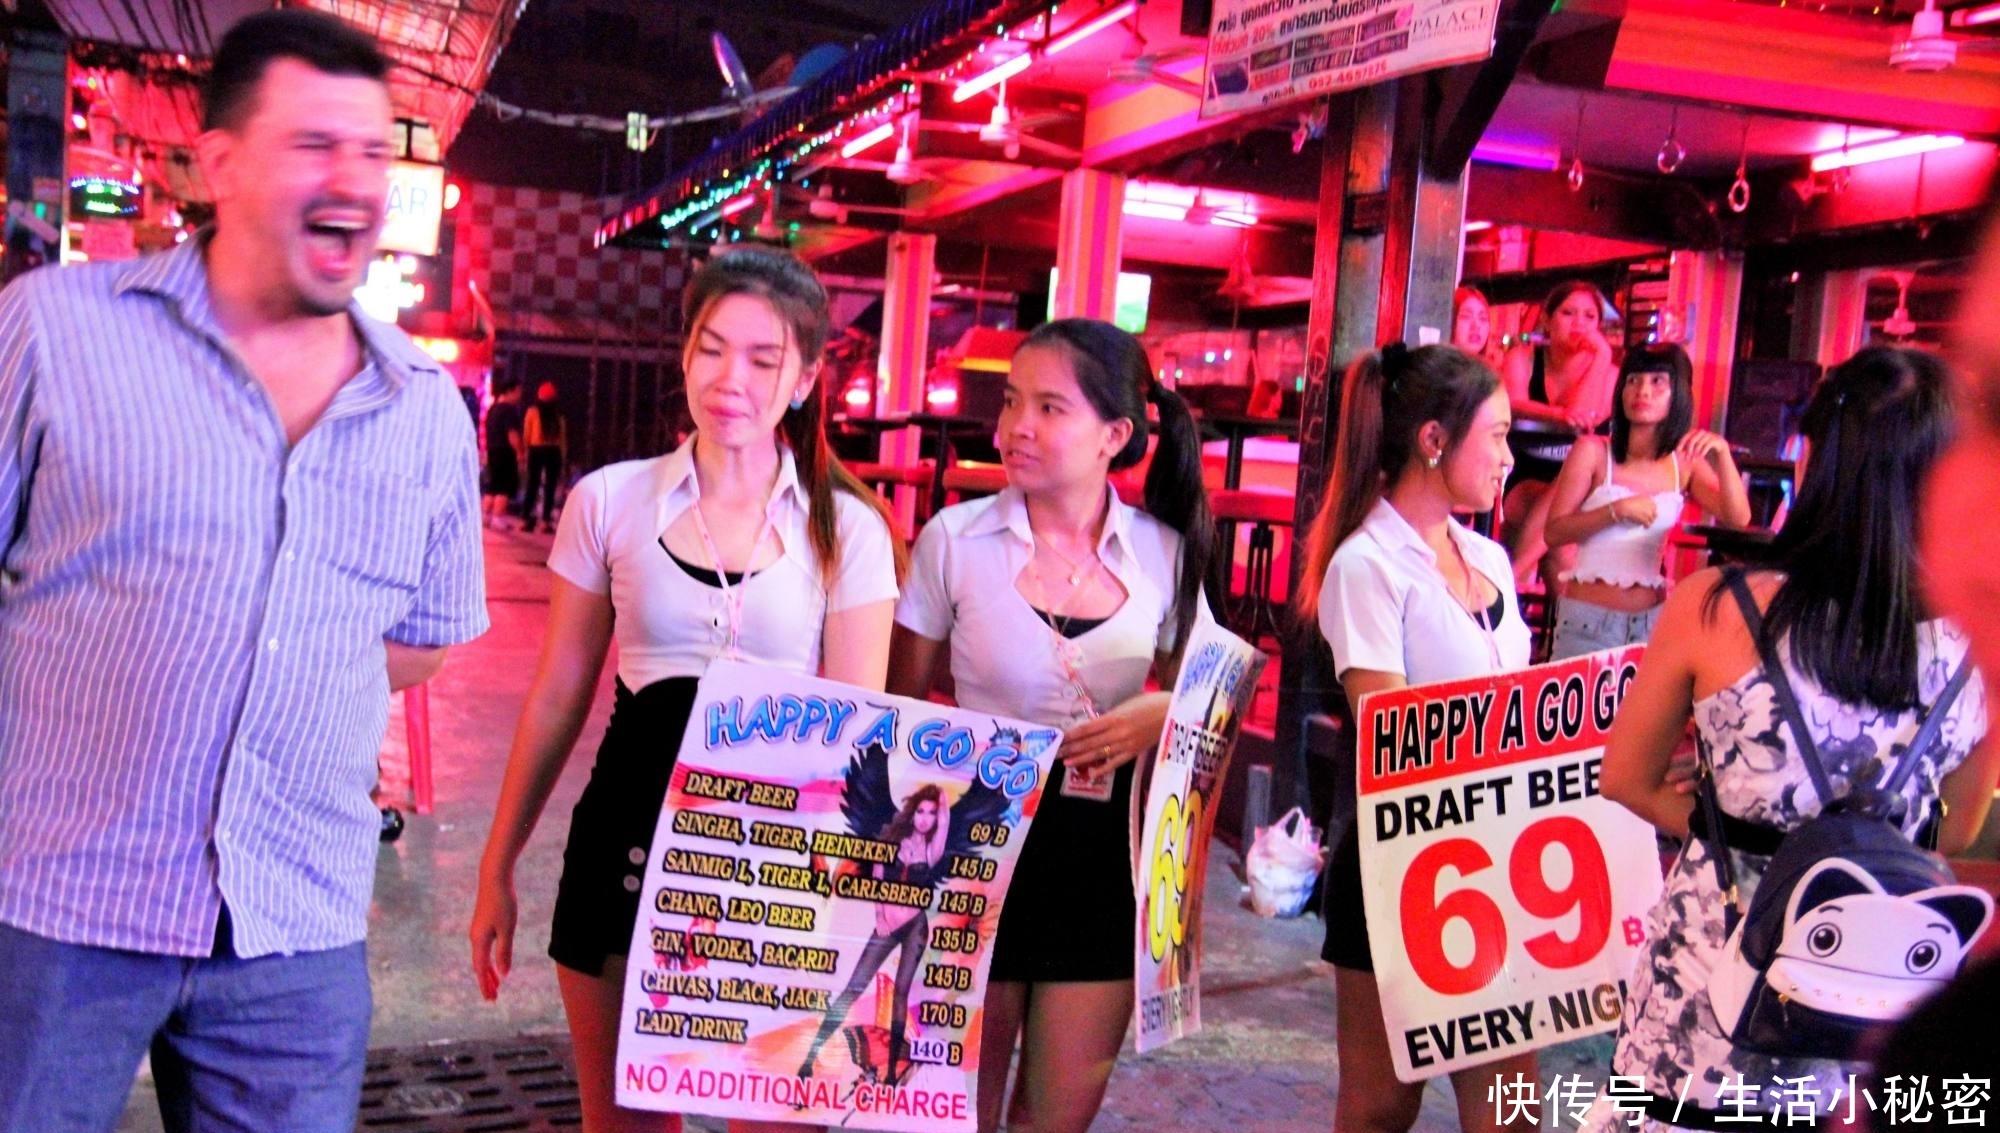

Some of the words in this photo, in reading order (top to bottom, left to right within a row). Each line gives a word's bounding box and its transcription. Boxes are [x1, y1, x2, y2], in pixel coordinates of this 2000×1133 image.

[1413, 6, 1489, 33] PALACE
[384, 184, 429, 217] AR
[706, 694, 855, 748] HAPPY
[853, 706, 899, 750] A
[909, 718, 974, 768] GO
[978, 743, 1040, 799] GO
[1373, 690, 1493, 780] HAPPY
[1500, 686, 1525, 752] A
[1535, 672, 1584, 744] GO
[684, 772, 746, 801] DRAFT
[748, 782, 797, 810] BEER
[970, 822, 991, 843] 69
[993, 827, 1009, 846] B
[1375, 776, 1513, 843] DRAFT
[1528, 758, 1601, 812] BEE
[674, 810, 743, 844] SINGHA,
[751, 822, 807, 851] TIGER,
[813, 832, 898, 863] HEINEKEN
[950, 856, 978, 878] 145
[981, 861, 996, 880] B
[1149, 789, 1202, 963] 69
[663, 851, 733, 880] SANMIG
[761, 863, 811, 890] TIGER
[837, 876, 931, 908] CARLSBERG
[940, 891, 968, 914] 145
[971, 895, 985, 915] B
[1399, 814, 1613, 998] 69
[657, 889, 722, 918] CHANG,
[728, 899, 764, 923] LEO
[767, 906, 815, 931] BEER
[932, 928, 960, 950] 135
[964, 932, 978, 952] B
[651, 929, 686, 956] GIN,
[693, 936, 757, 964] VODKA,
[762, 943, 838, 973] BACARDI
[924, 965, 953, 988] 145
[957, 970, 971, 990] B
[642, 971, 712, 1001] CHIVAS,
[718, 978, 780, 1008] BLACK,
[784, 987, 831, 1011] JACK
[920, 1003, 948, 1025] 170
[953, 1007, 966, 1027] B
[637, 1010, 688, 1036] LADY
[690, 1018, 748, 1043] DRINK
[911, 1040, 944, 1059] 140
[949, 1045, 963, 1065] B
[1404, 1000, 1536, 1070] EVERY
[626, 1063, 668, 1094] NO
[675, 1068, 847, 1111] ADDITIONAL
[855, 1082, 968, 1121] CHARGE
